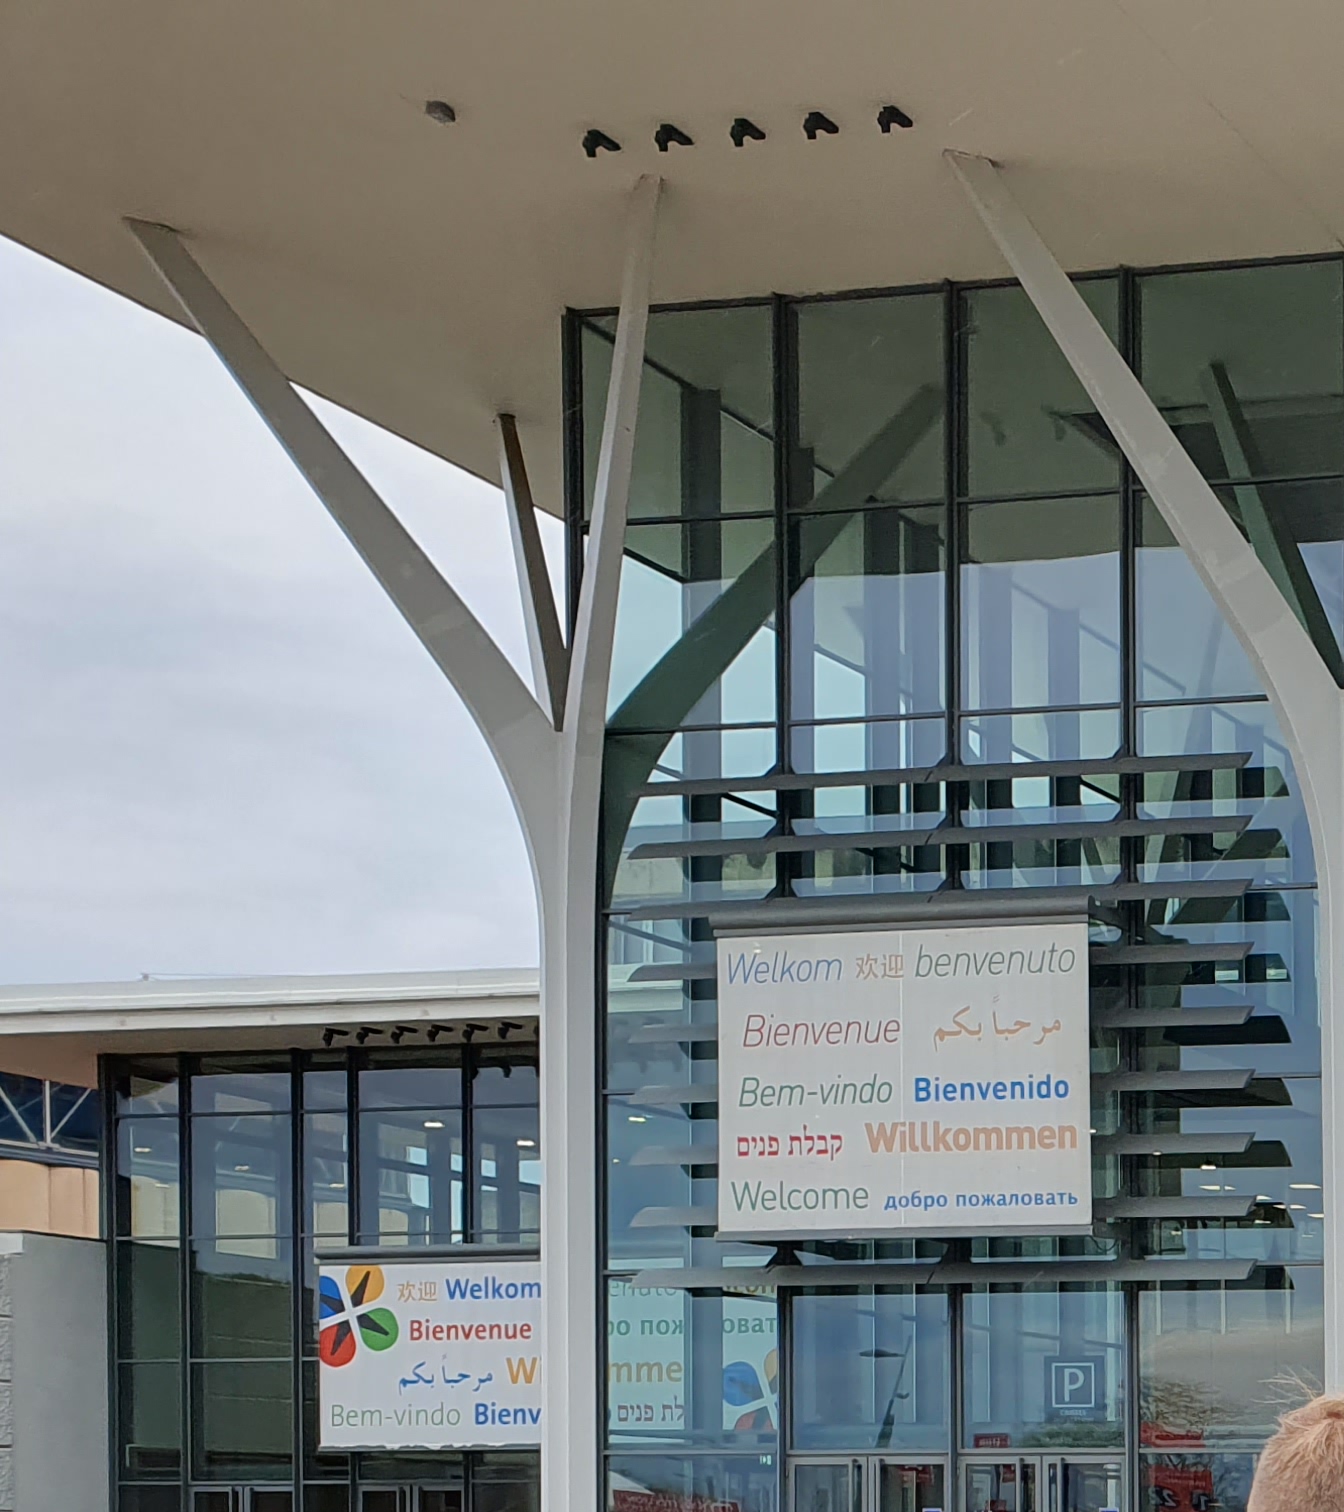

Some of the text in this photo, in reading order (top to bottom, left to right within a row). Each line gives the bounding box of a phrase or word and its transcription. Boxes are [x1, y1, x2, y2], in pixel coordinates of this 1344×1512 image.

[727, 951, 842, 984] Welkom
[855, 953, 904, 980] 欢迎
[914, 942, 1076, 978] benvenuto
[742, 1014, 900, 1048] Bienvenue
[738, 1073, 893, 1107] Bem-vindo
[914, 1074, 1070, 1102] Bienvenido
[736, 1124, 843, 1161] קבלת פנים
[864, 1121, 1078, 1154] Willkommen
[731, 1180, 869, 1212] Welcome
[884, 1190, 1078, 1212] добро пожаловать
[397, 1280, 438, 1303] 欢迎
[445, 1276, 541, 1300] Welkom
[409, 1319, 532, 1341] Bienvenue
[1064, 1368, 1085, 1402] P
[331, 1403, 461, 1427] Bem-vindo
